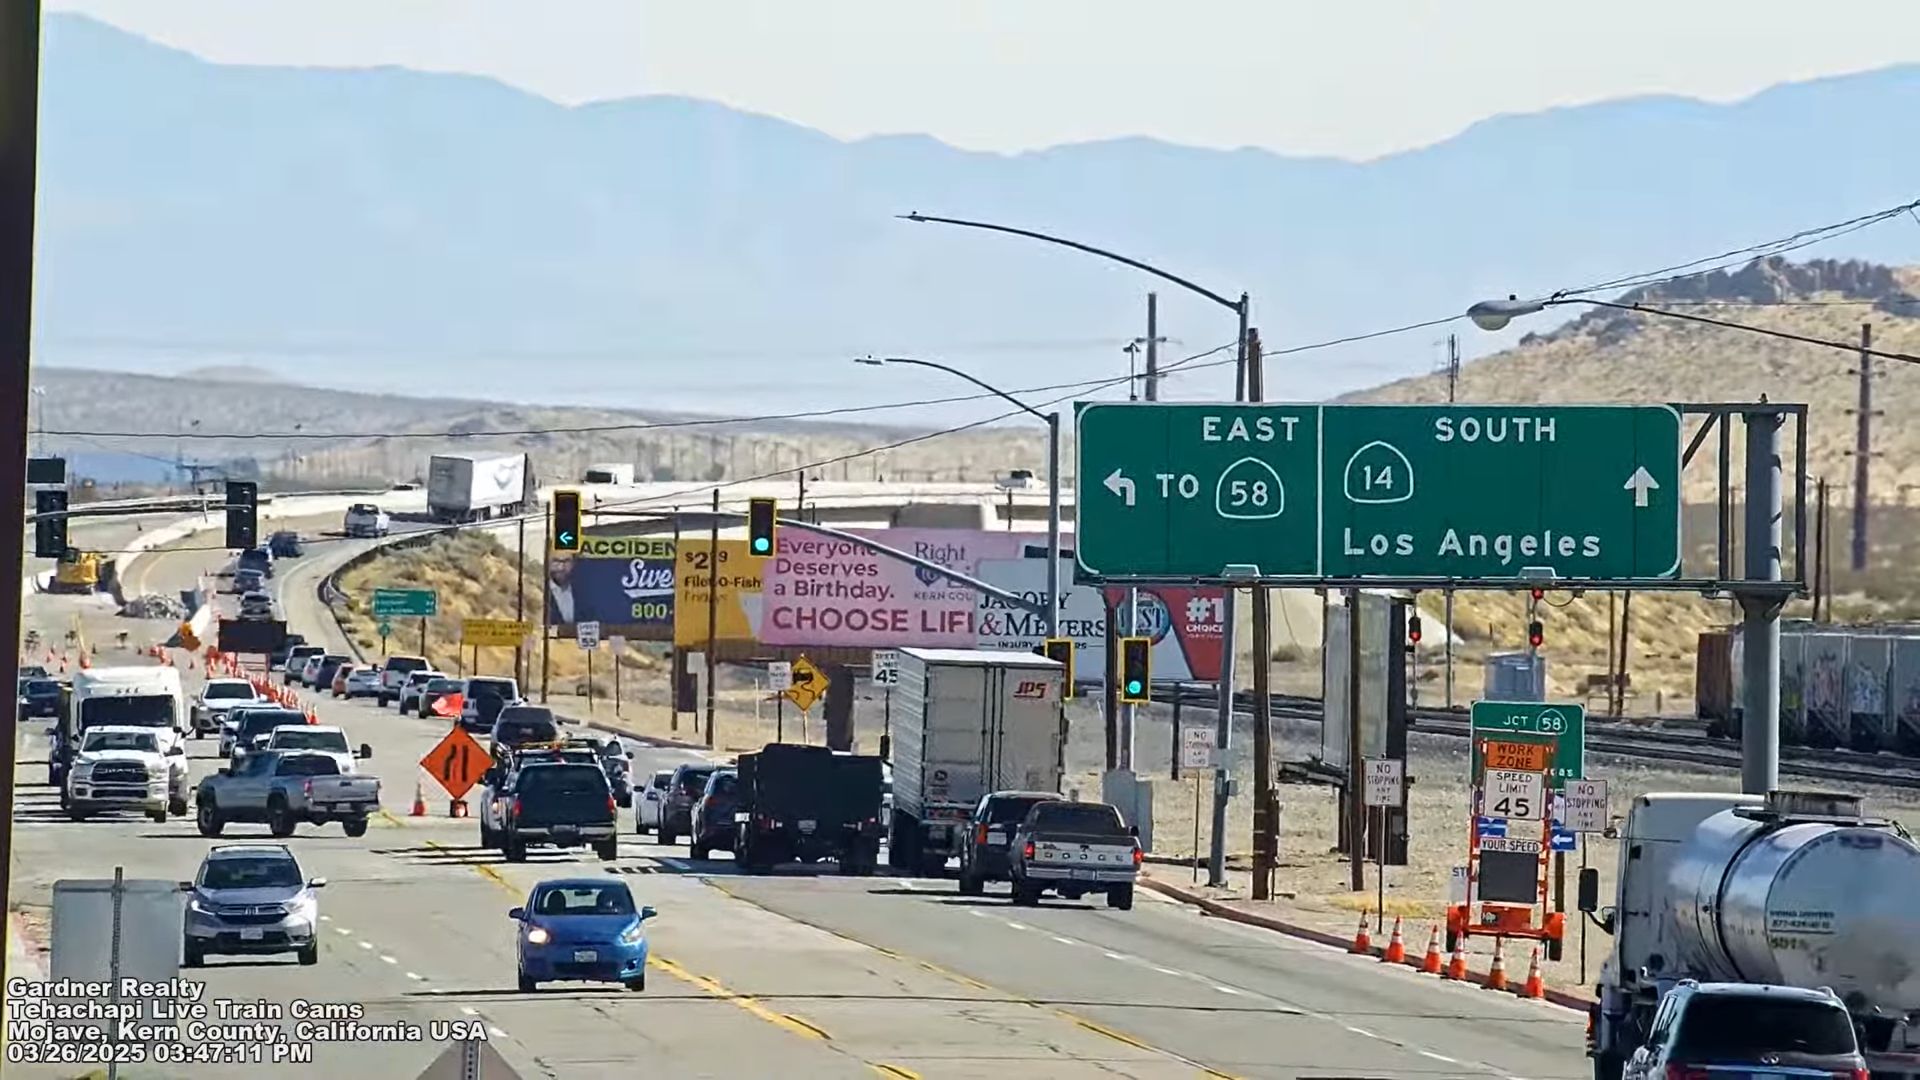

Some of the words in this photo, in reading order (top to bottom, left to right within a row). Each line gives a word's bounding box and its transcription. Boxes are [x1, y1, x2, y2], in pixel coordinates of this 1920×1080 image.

[1203, 416, 1299, 441] EAST
[1435, 417, 1555, 442] SOUTH
[1364, 465, 1393, 490] 14
[1156, 474, 1199, 498] TO
[1231, 481, 1268, 506] 58
[915, 541, 965, 564] Right
[1344, 527, 1414, 555] Los
[1438, 528, 1600, 565] Angeles
[685, 551, 728, 569] $29
[776, 558, 878, 575] Deserves
[774, 583, 786, 596] a
[795, 581, 895, 602] Birthday.
[914, 592, 946, 600] KERN
[773, 607, 908, 632] CHOOSE
[1004, 612, 1105, 638] MEERS
[998, 641, 1033, 650] INJURY
[875, 669, 898, 683] 45
[1503, 715, 1528, 726] JCT
[1542, 717, 1561, 731] 58
[1497, 743, 1534, 756] WORK
[1376, 764, 1391, 774] NO
[1497, 755, 1532, 768] ZONE
[1496, 772, 1532, 783] SPEED
[1499, 783, 1528, 794] LIMIT
[1578, 785, 1595, 795] NO
[1494, 797, 1530, 818] 45
[1567, 798, 1605, 809] STOPPING
[1482, 839, 1507, 850] YOUR
[1510, 841, 1540, 854] SPEED
